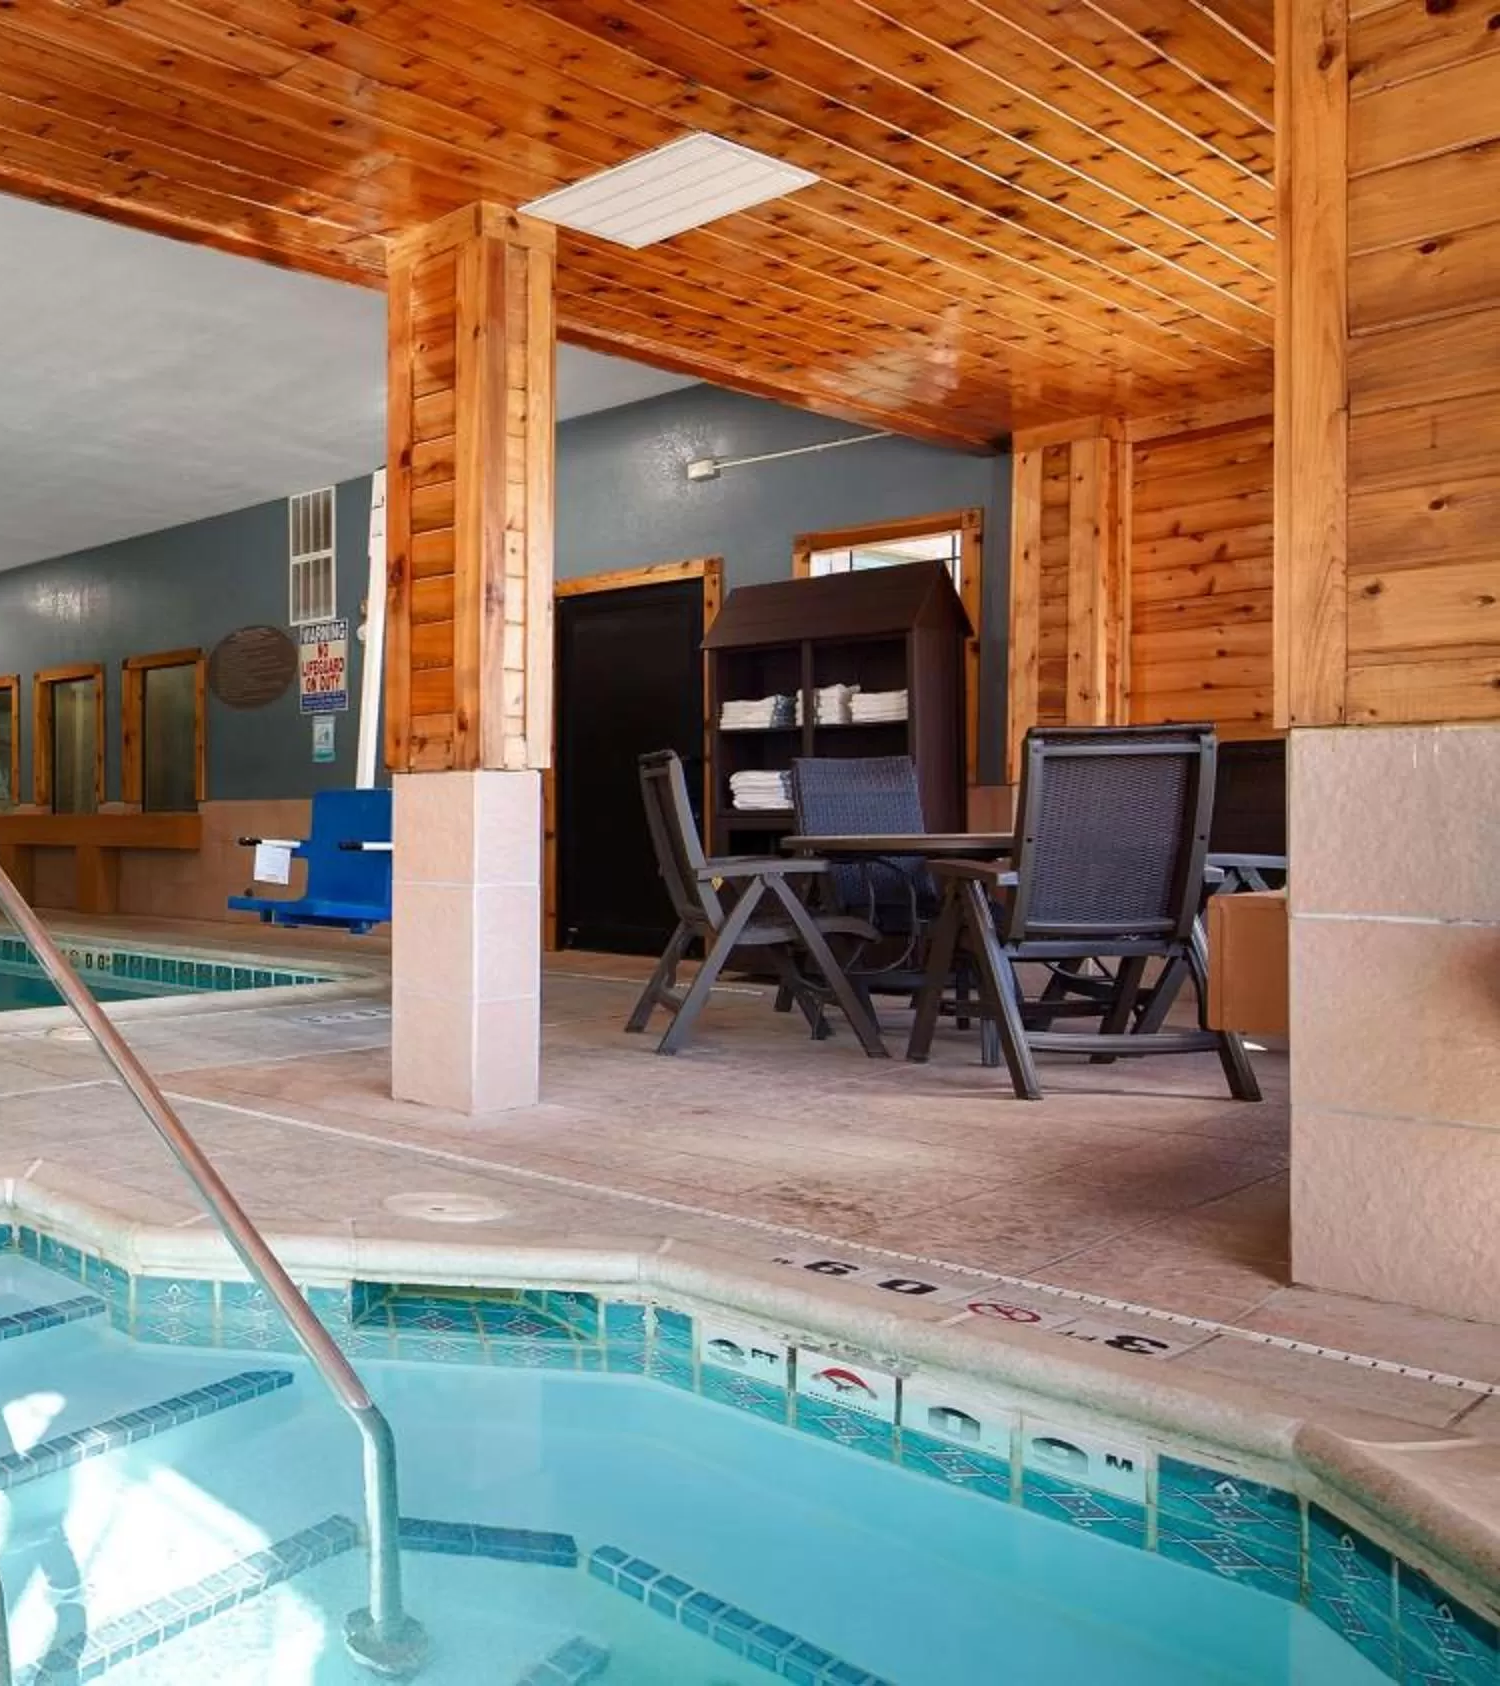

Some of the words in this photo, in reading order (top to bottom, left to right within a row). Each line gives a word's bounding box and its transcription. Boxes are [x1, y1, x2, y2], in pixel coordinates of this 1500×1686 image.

[301, 621, 346, 643] WARNING
[317, 641, 329, 658] NO
[302, 657, 345, 677] LIFEGUARD
[305, 678, 317, 693] ON
[320, 675, 341, 691] DUTY
[1105, 1453, 1134, 1473] M
